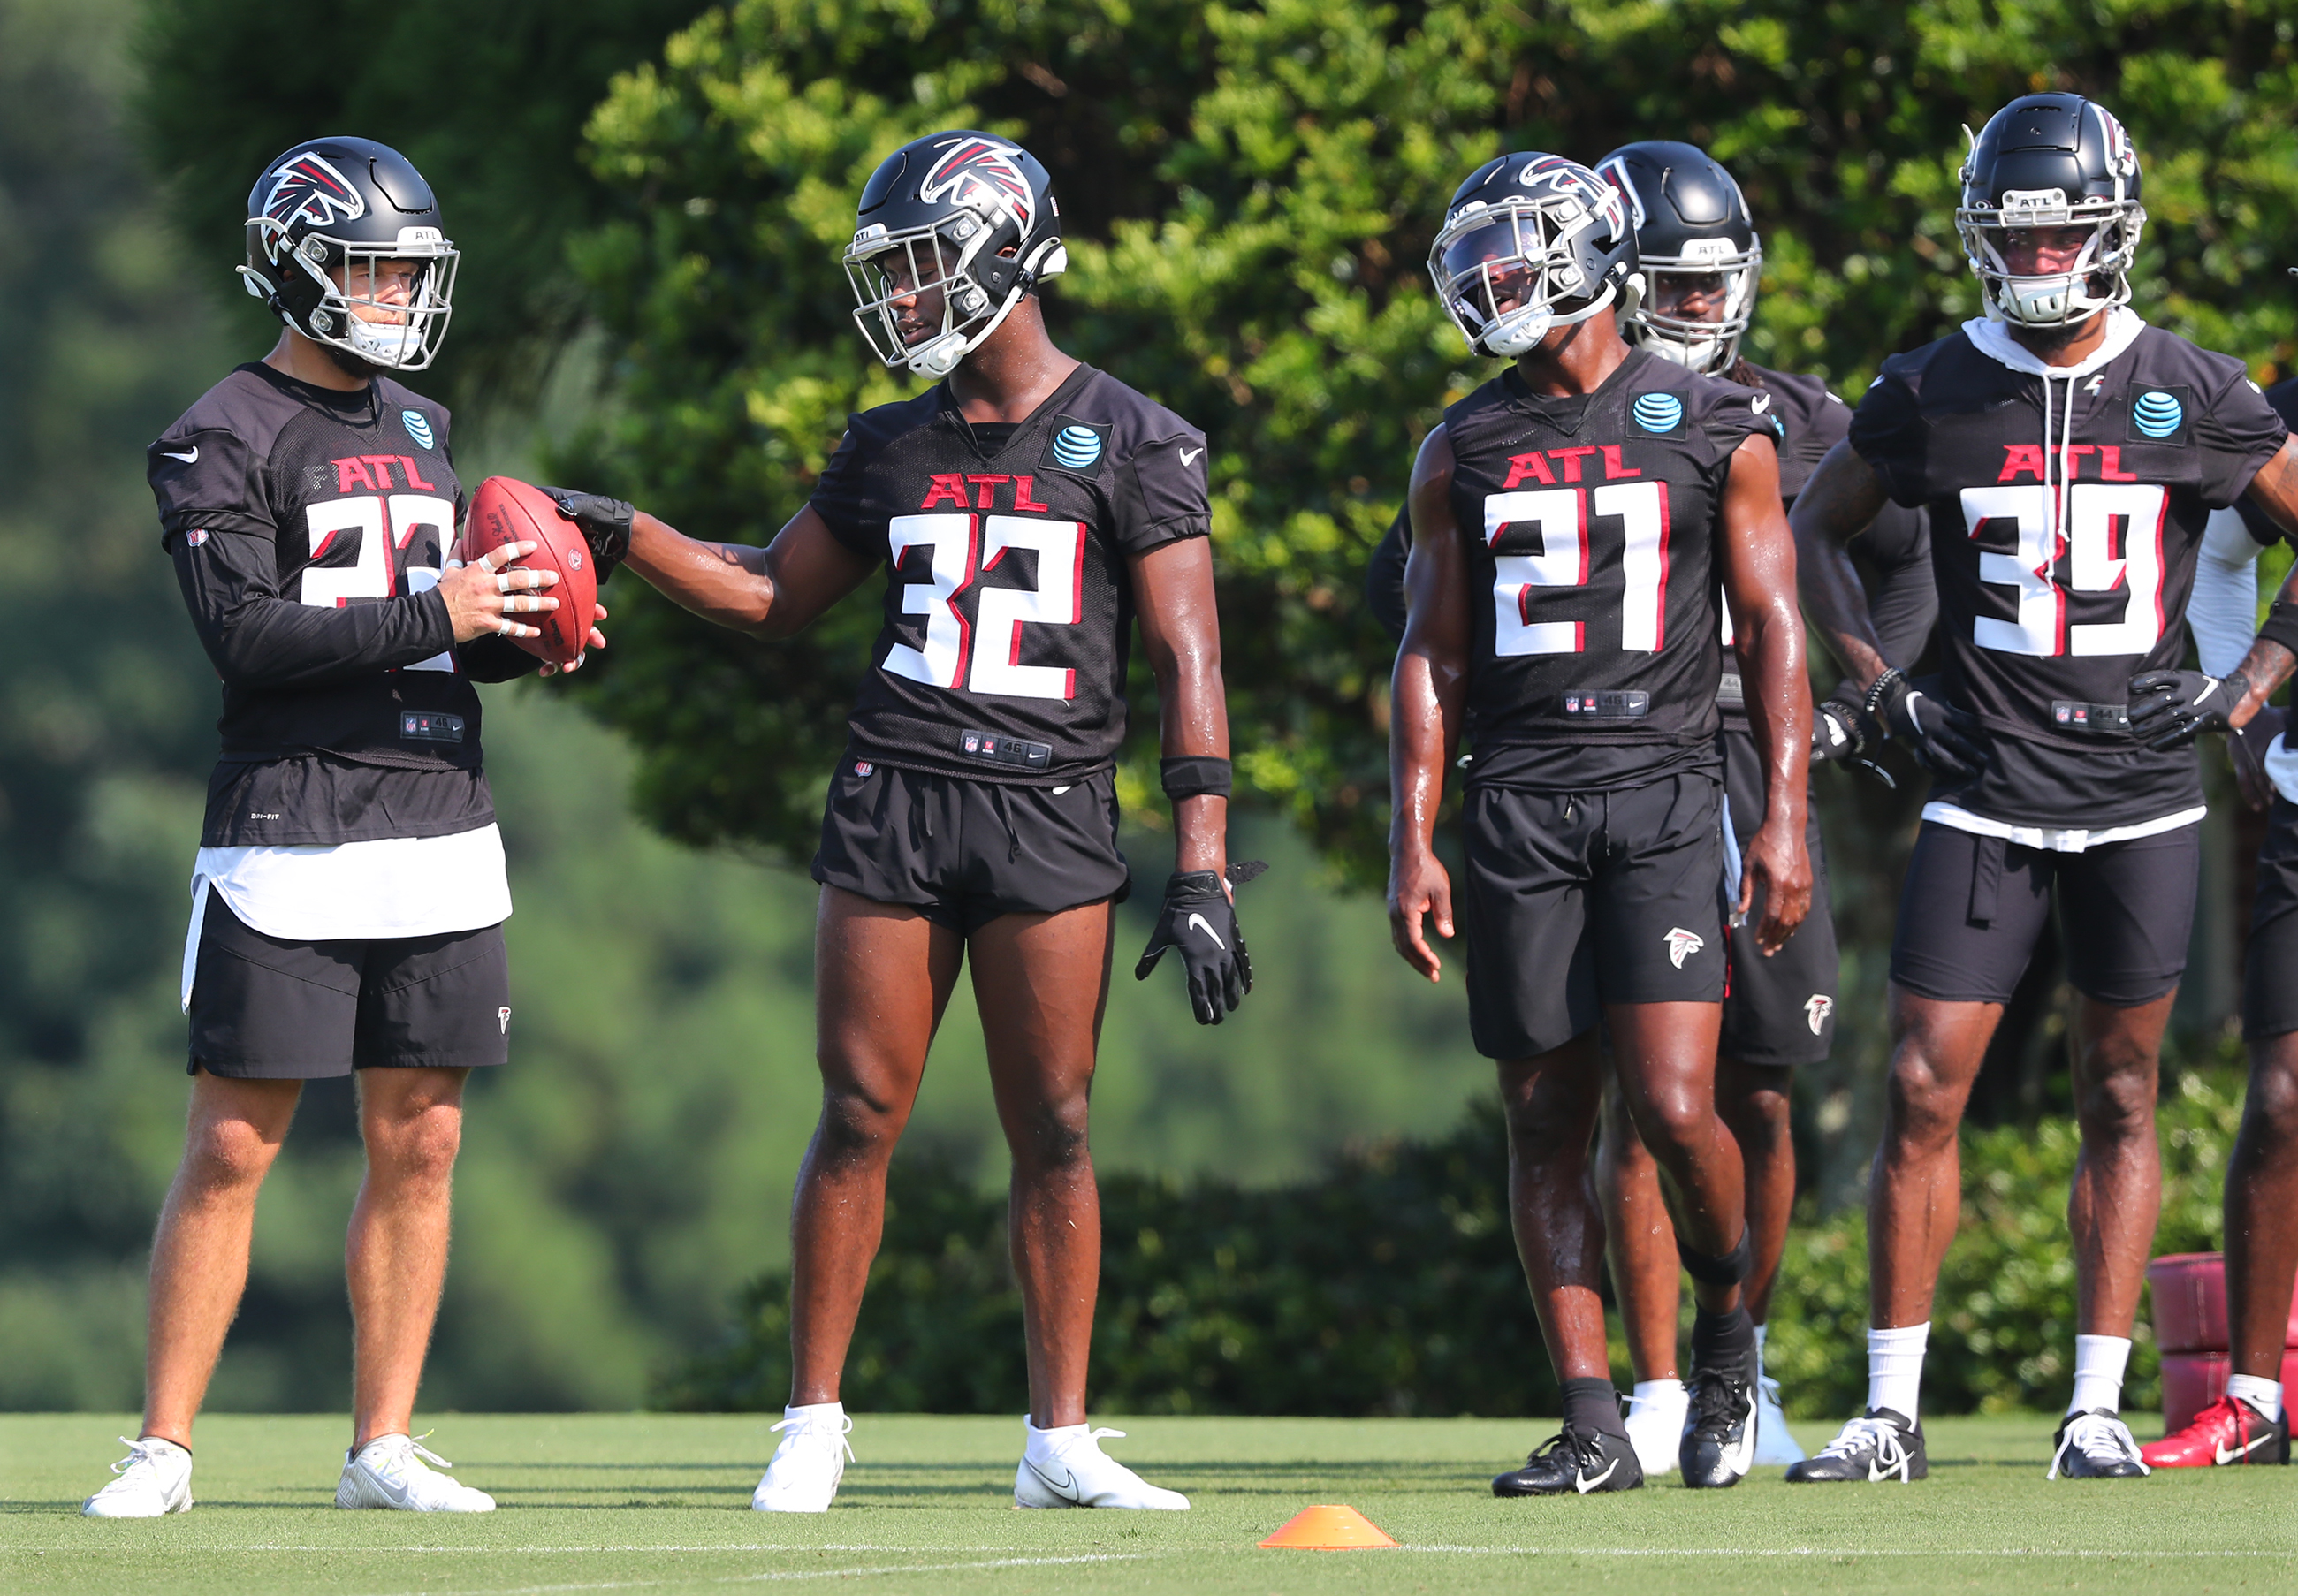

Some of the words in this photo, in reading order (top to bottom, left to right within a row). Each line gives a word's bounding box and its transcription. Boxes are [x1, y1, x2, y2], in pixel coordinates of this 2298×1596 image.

[2020, 198, 2051, 207] ATL
[415, 231, 437, 239] ATL
[1698, 246, 1724, 255] ATL
[331, 454, 436, 492] ATL
[1503, 445, 1641, 488] ATL
[1997, 445, 2137, 483] ATL
[920, 473, 1048, 513] ATL
[1484, 481, 1670, 657] 21
[1959, 483, 2172, 657] 39
[881, 513, 1087, 700] 32
[435, 717, 448, 727] 46
[1003, 741, 1022, 753] 46
